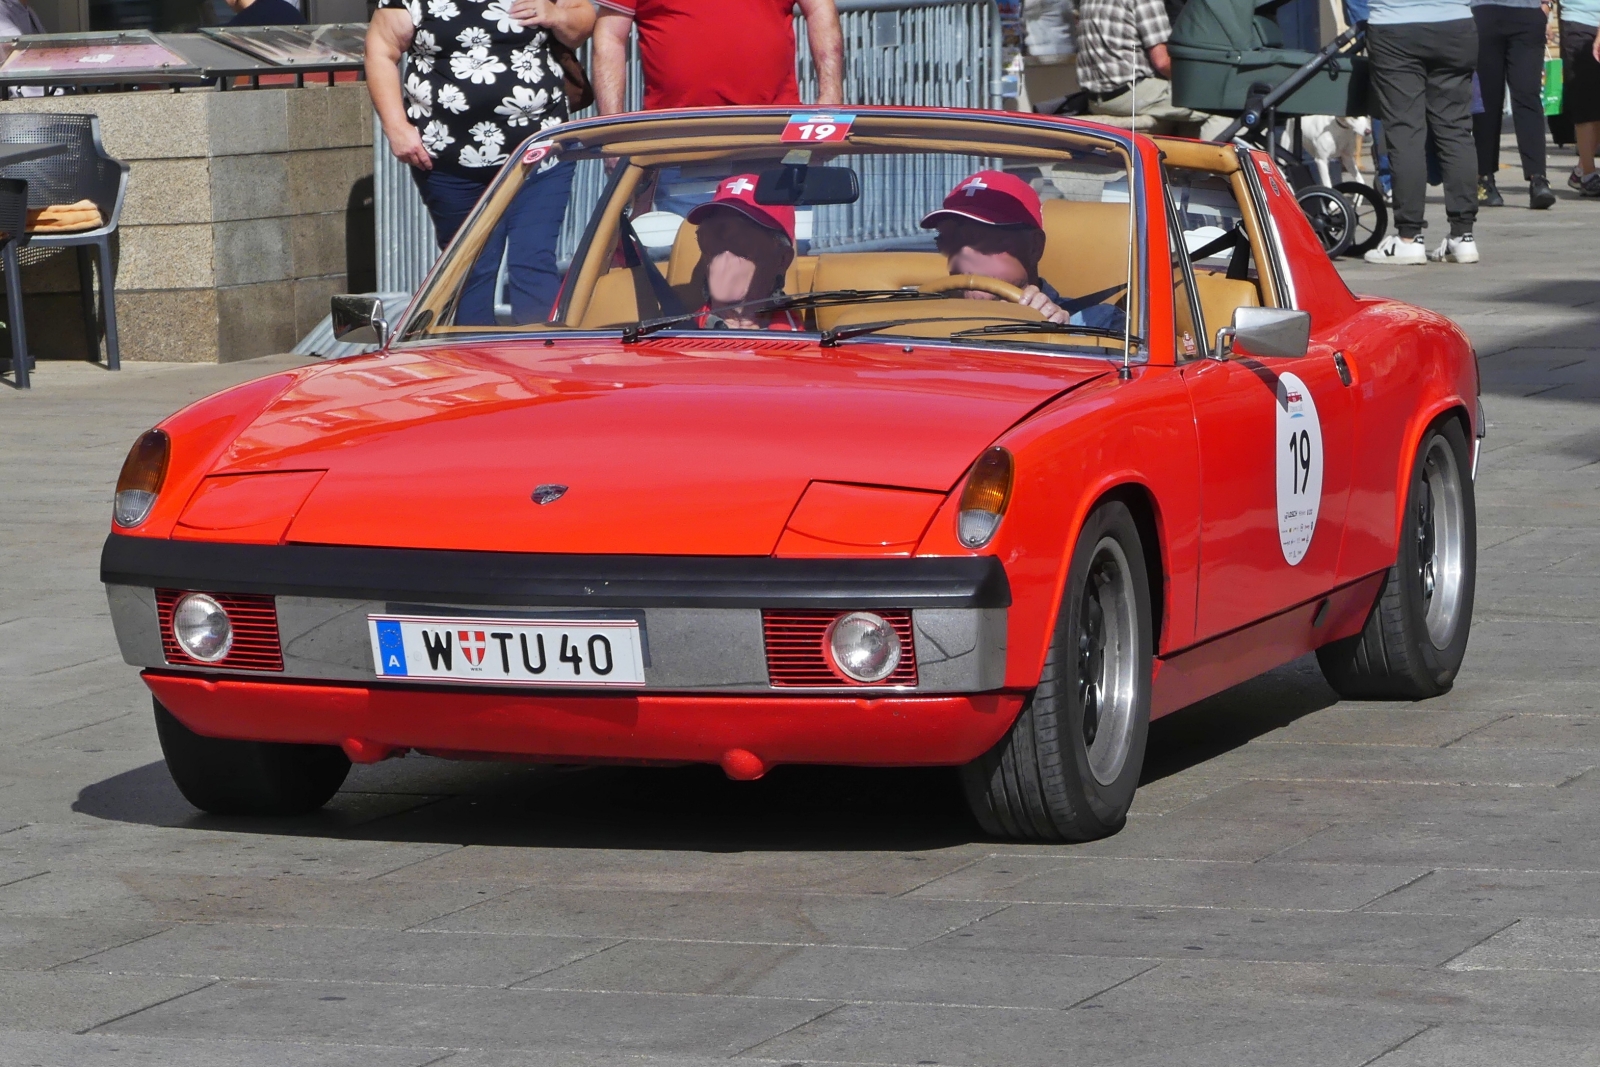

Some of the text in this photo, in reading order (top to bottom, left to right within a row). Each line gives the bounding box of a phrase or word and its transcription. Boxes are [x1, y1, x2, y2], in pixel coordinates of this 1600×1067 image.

[798, 124, 837, 140] 19
[1289, 429, 1311, 495] 19
[388, 655, 400, 668] A
[422, 630, 613, 675] W TU 40
